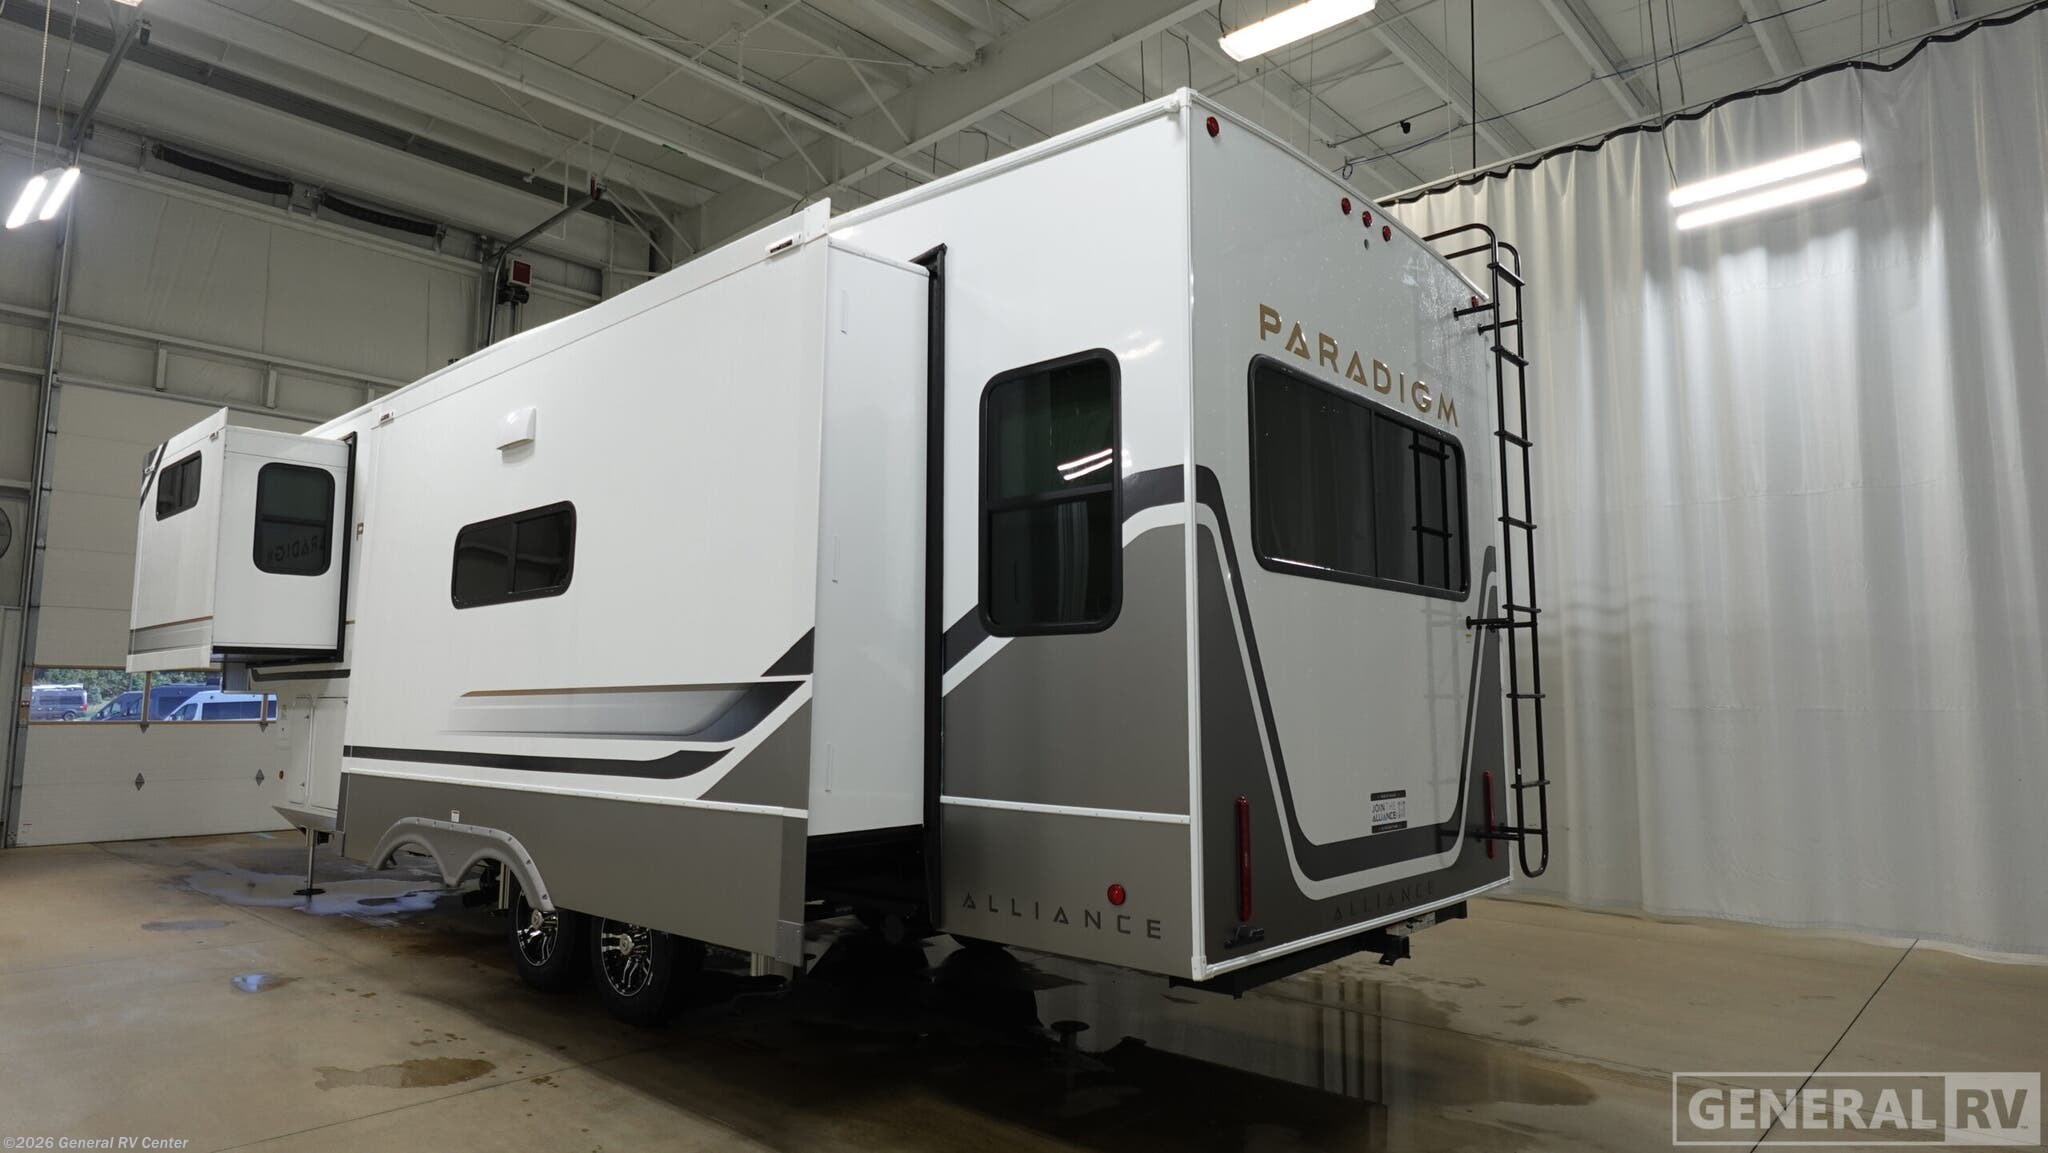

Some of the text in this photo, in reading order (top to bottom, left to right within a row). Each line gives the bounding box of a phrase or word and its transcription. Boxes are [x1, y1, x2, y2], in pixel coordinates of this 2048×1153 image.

[1258, 302, 1460, 428] PARADIGM
[961, 893, 1162, 939] ALLIANCE
[1334, 879, 1434, 921] ALLIANCE
